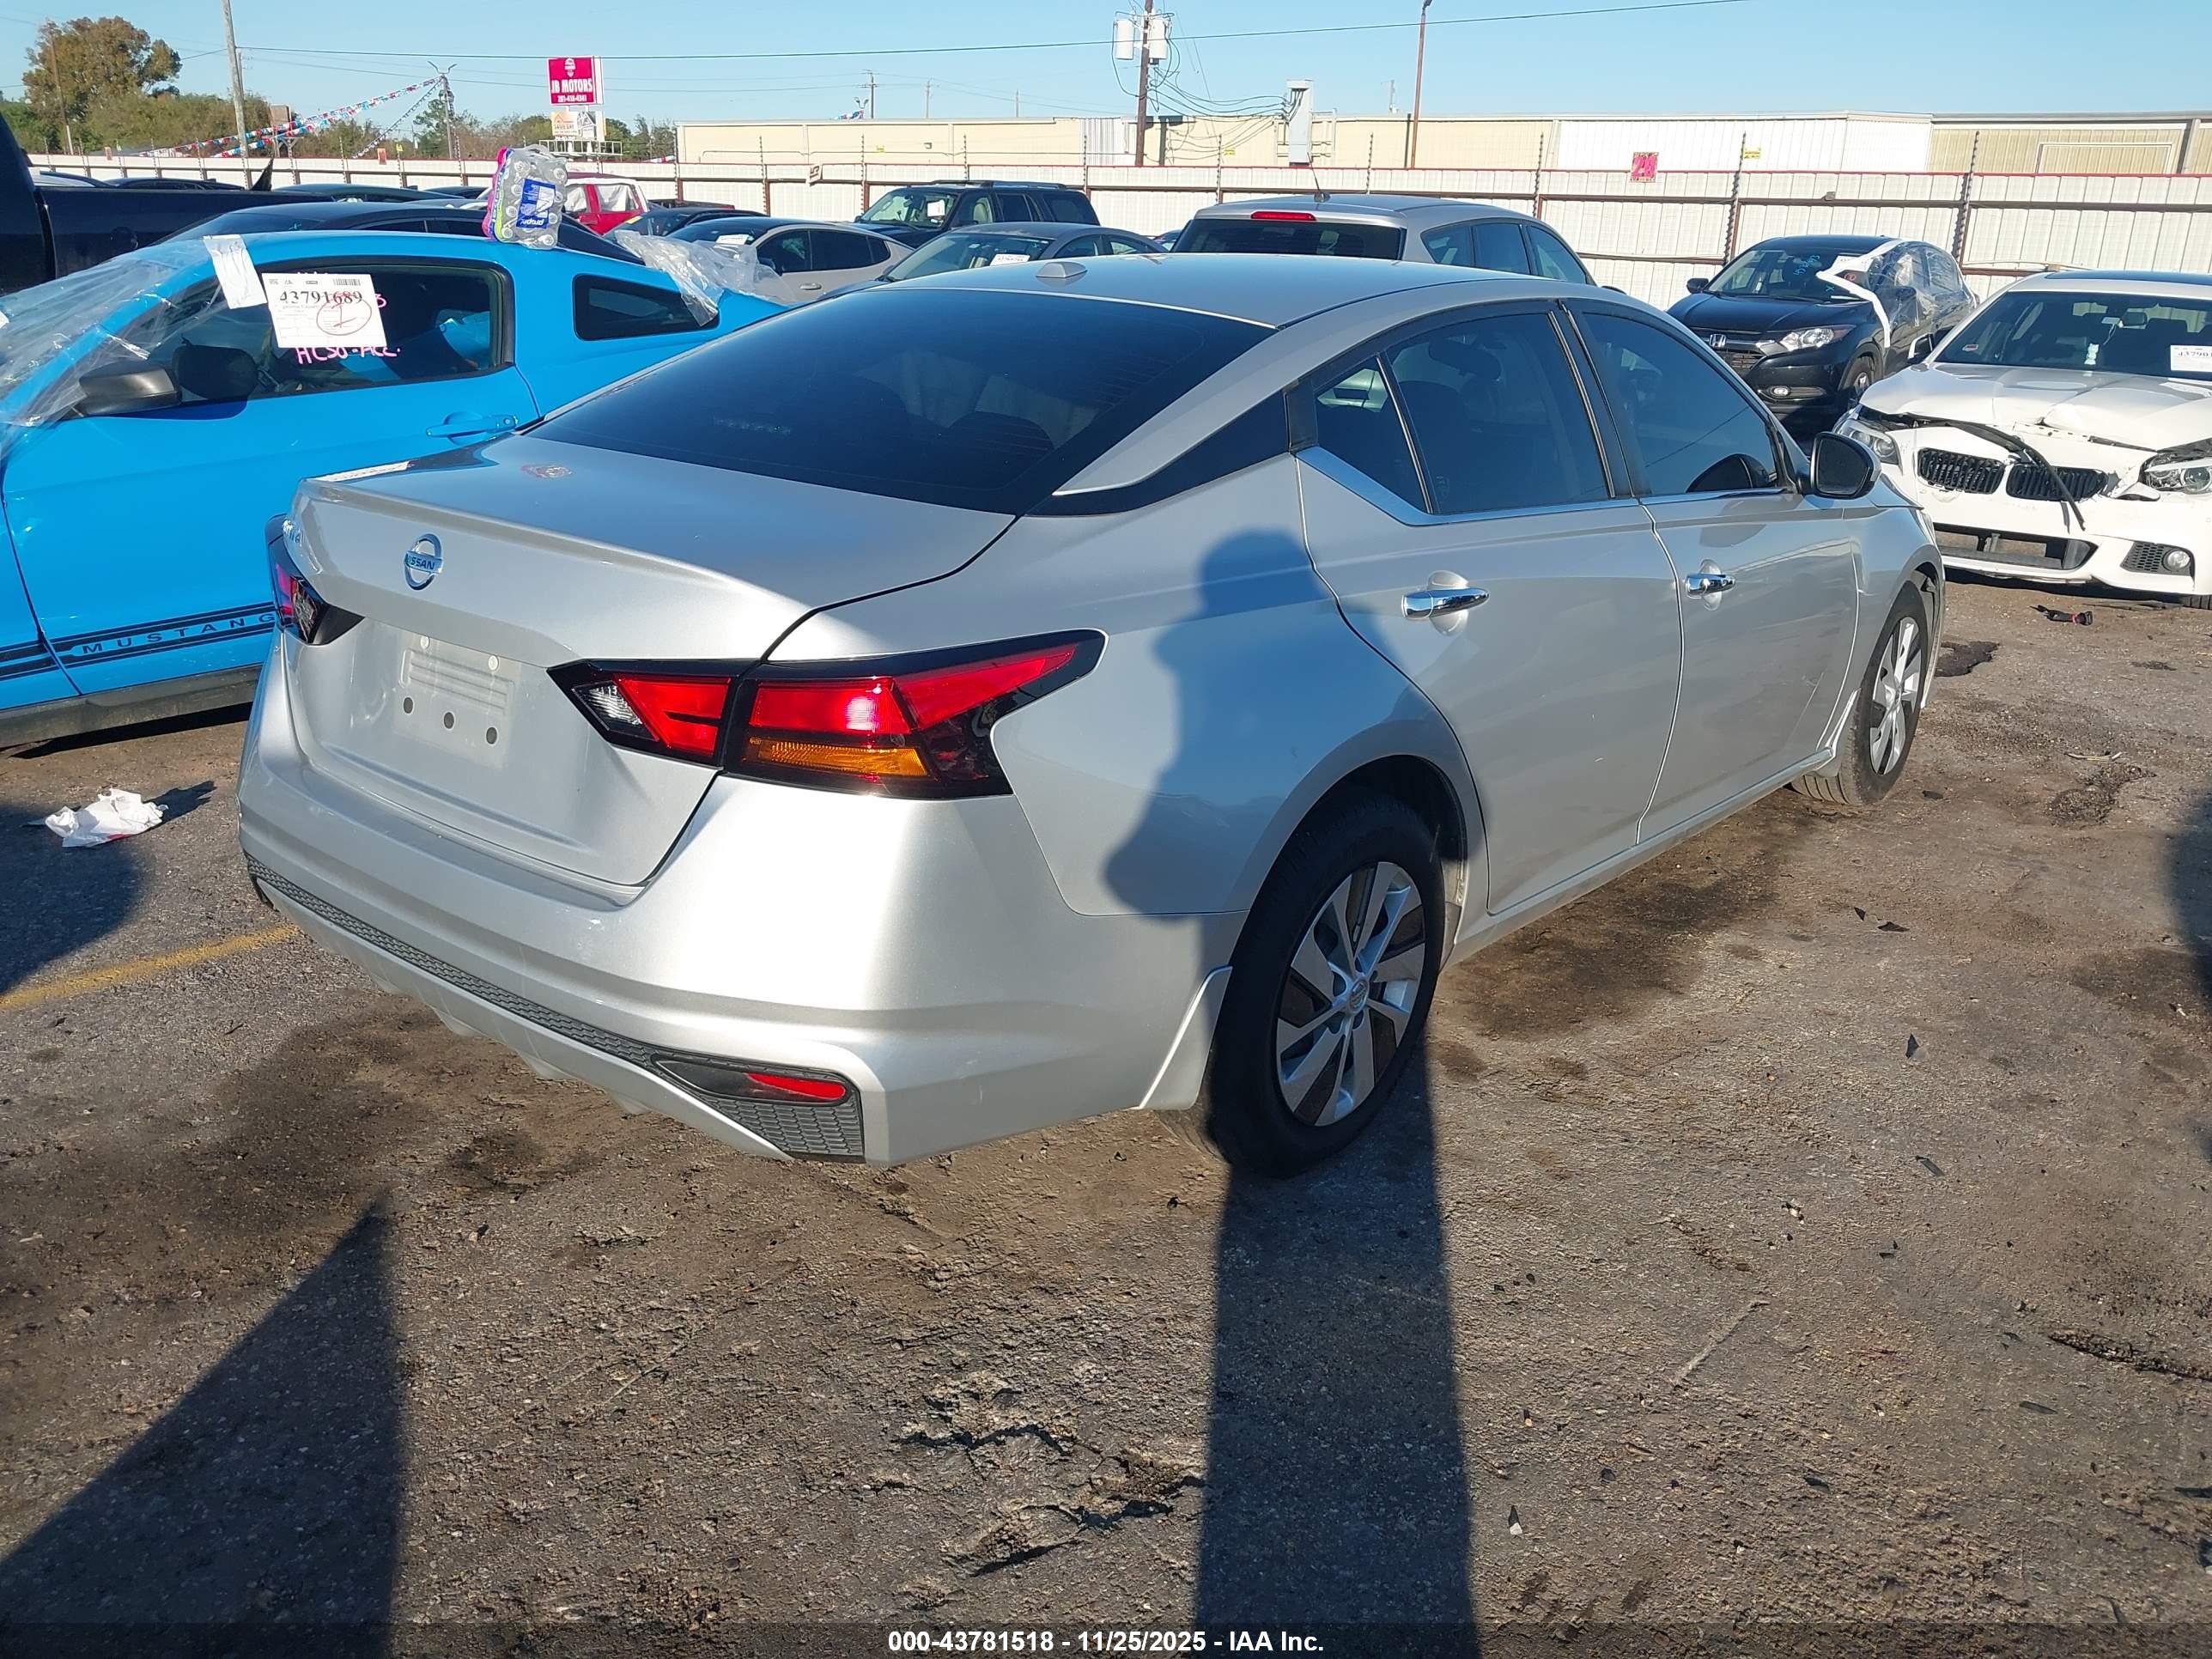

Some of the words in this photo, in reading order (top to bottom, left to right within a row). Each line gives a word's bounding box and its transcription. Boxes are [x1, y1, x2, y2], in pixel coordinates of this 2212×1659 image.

[551, 79, 561, 94] JB
[561, 78, 593, 93] MOTORS
[279, 290, 363, 304] 43791689
[82, 612, 276, 655] MUSTANG
